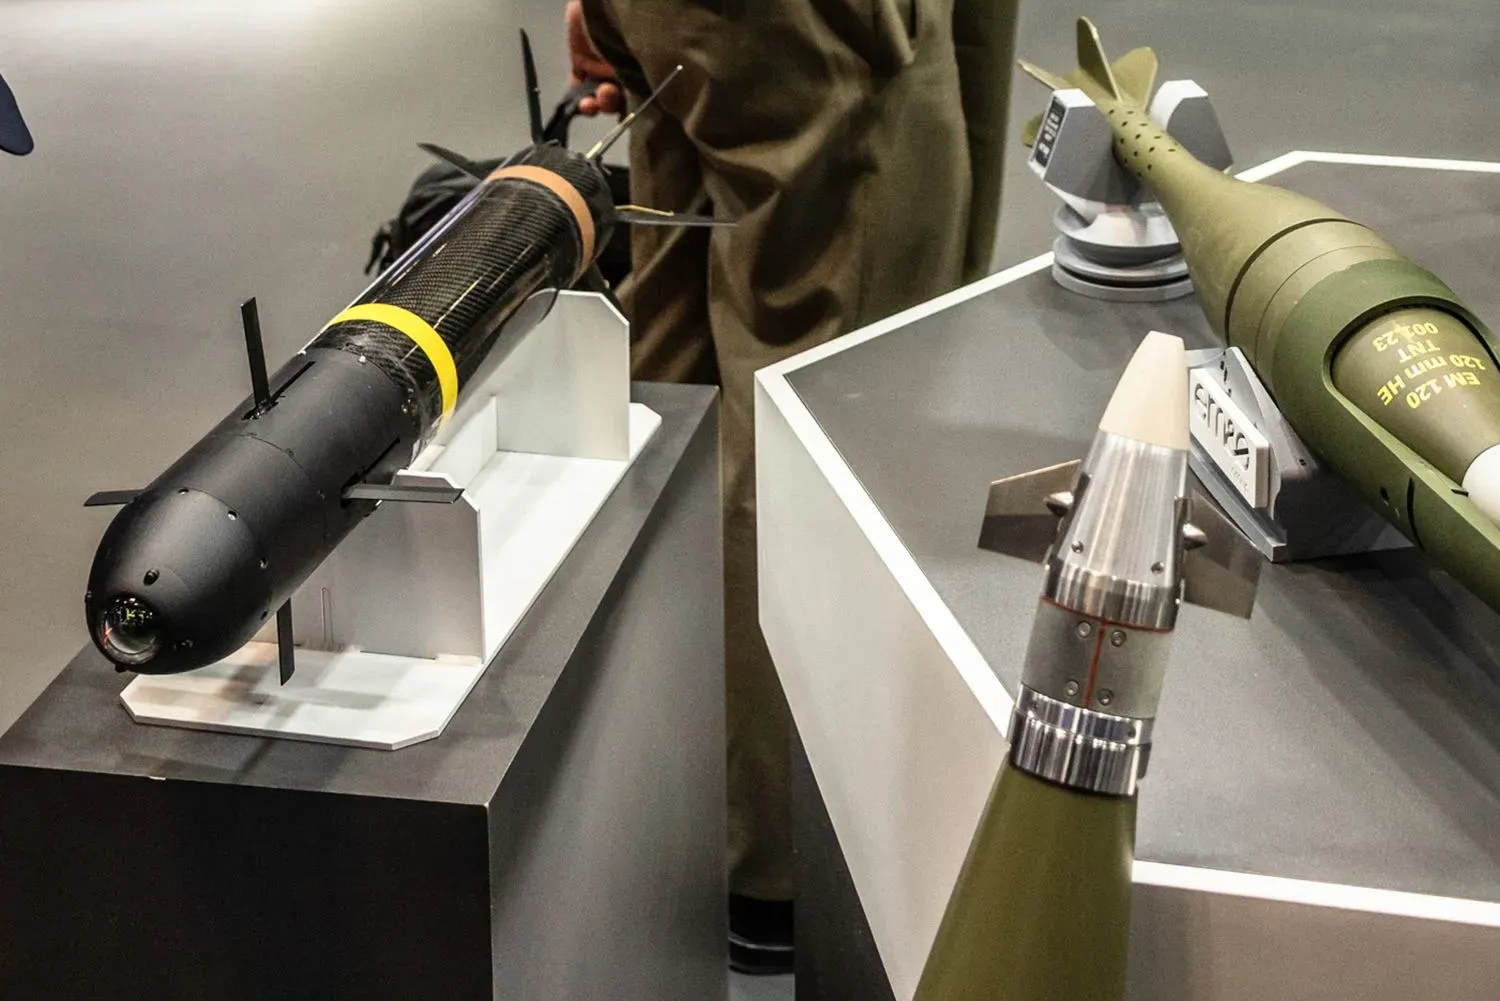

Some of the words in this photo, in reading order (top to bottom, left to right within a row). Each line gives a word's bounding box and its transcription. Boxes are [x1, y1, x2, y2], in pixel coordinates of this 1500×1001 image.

[1396, 338, 1440, 364] TNT
[1449, 353, 1487, 370] 120
[1404, 355, 1448, 379] mm
[1443, 371, 1481, 388] EM
[1376, 373, 1406, 406] HE
[1405, 378, 1442, 409] 120
